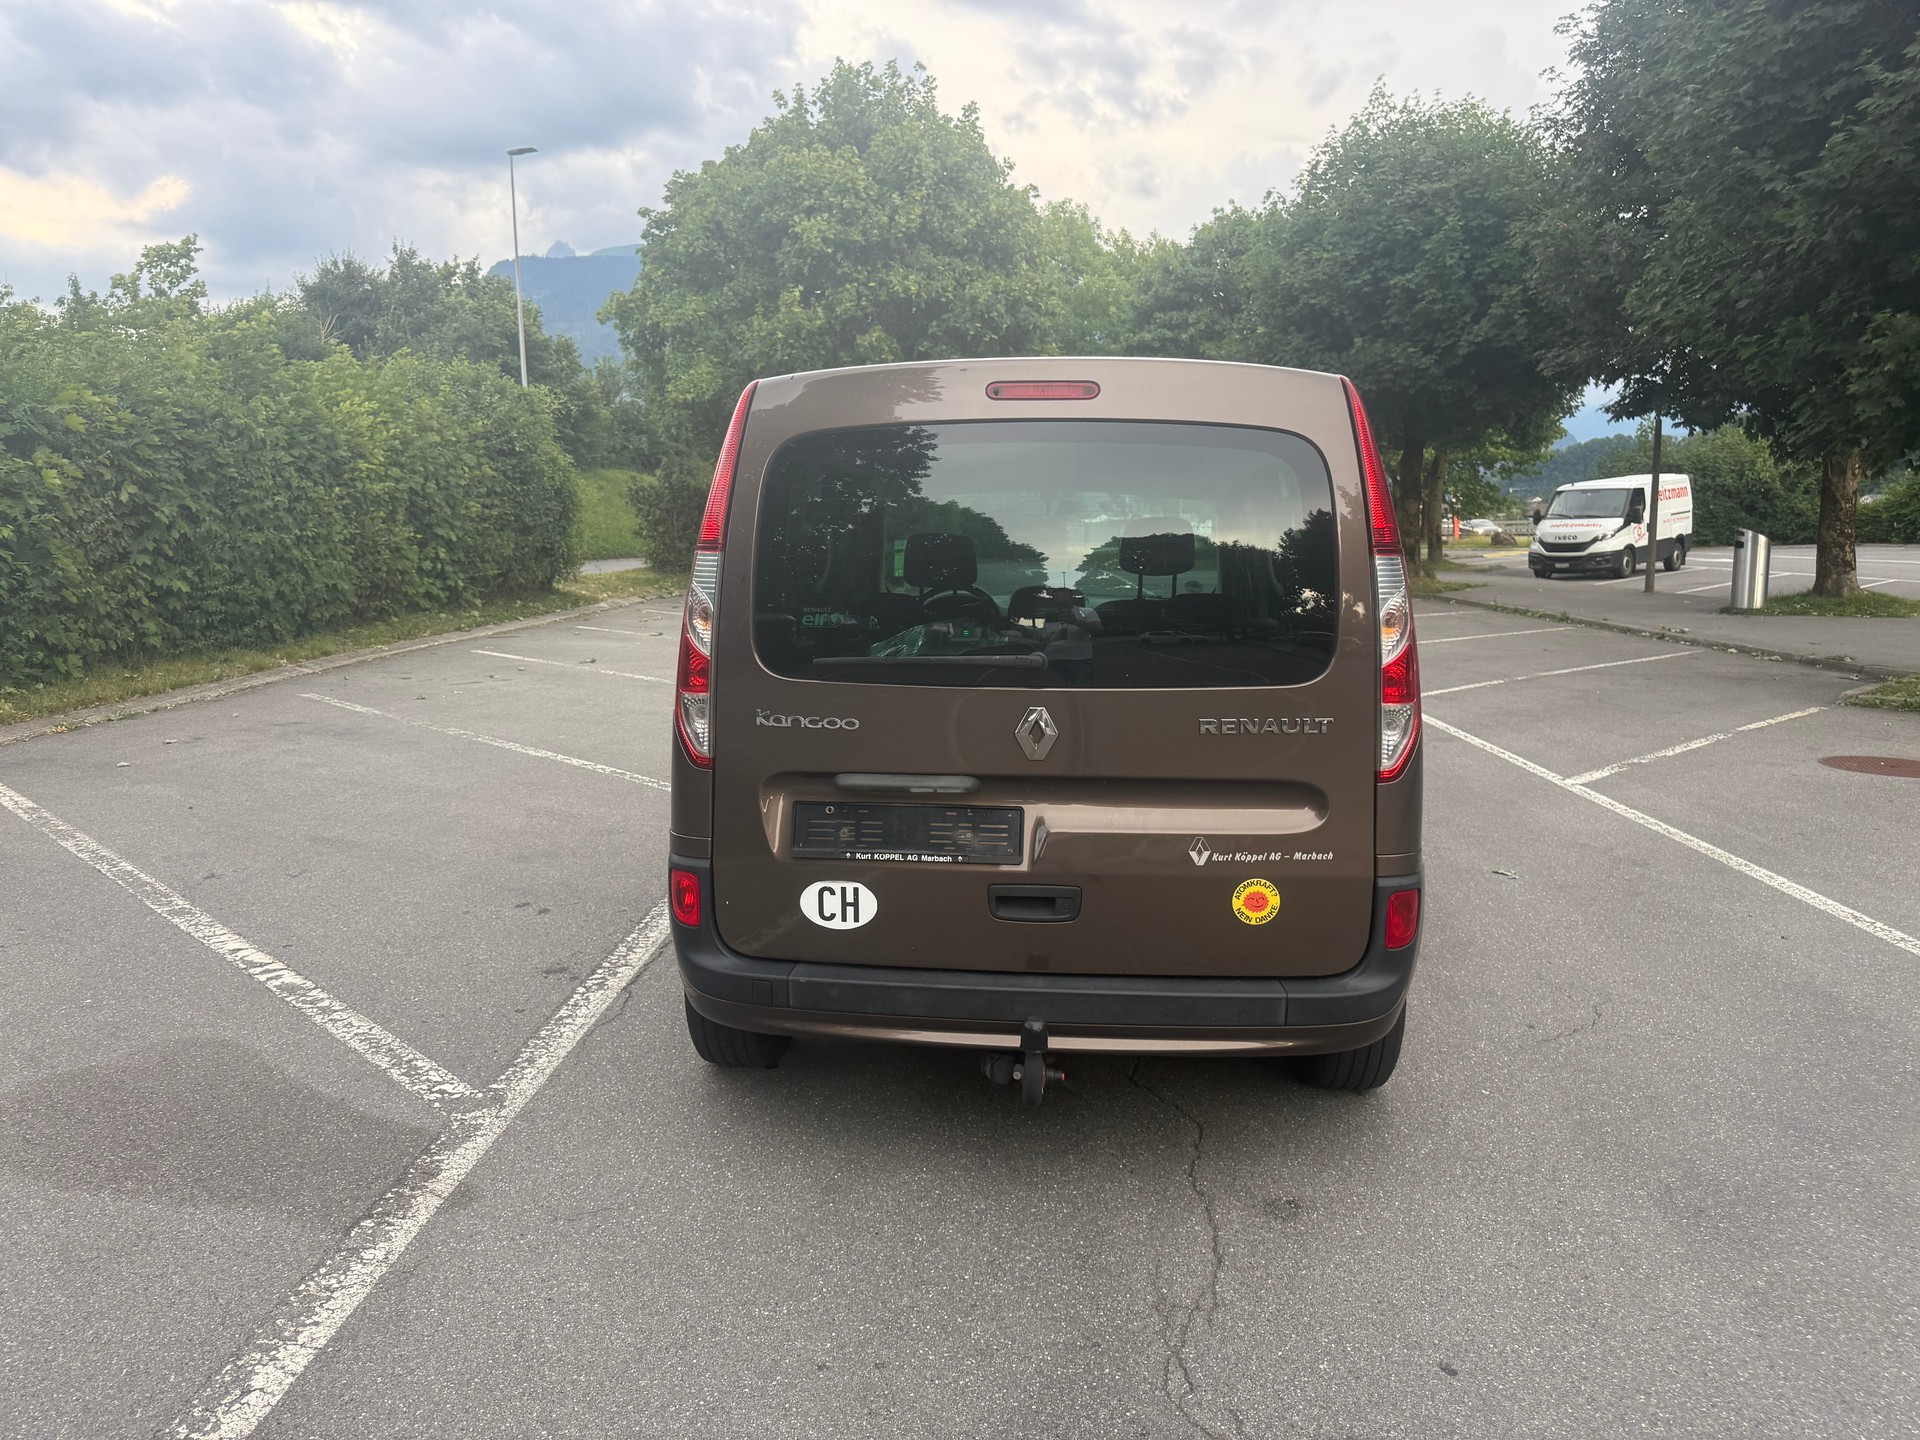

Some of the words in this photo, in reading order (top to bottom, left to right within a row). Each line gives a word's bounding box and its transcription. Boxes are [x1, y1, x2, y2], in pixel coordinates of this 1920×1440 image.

[1656, 486, 1689, 501] eitzmann
[801, 613, 829, 626] elf
[1198, 717, 1335, 735] RENAULT
[855, 852, 871, 860] Kurt
[1211, 852, 1232, 861] Kurt
[1234, 851, 1267, 863] Köppel
[1269, 852, 1282, 861] AG
[1293, 851, 1334, 861] Marbach
[1234, 879, 1278, 900] ATOMKRAFT?
[818, 886, 860, 923] CH
[1235, 907, 1253, 923] NEIN
